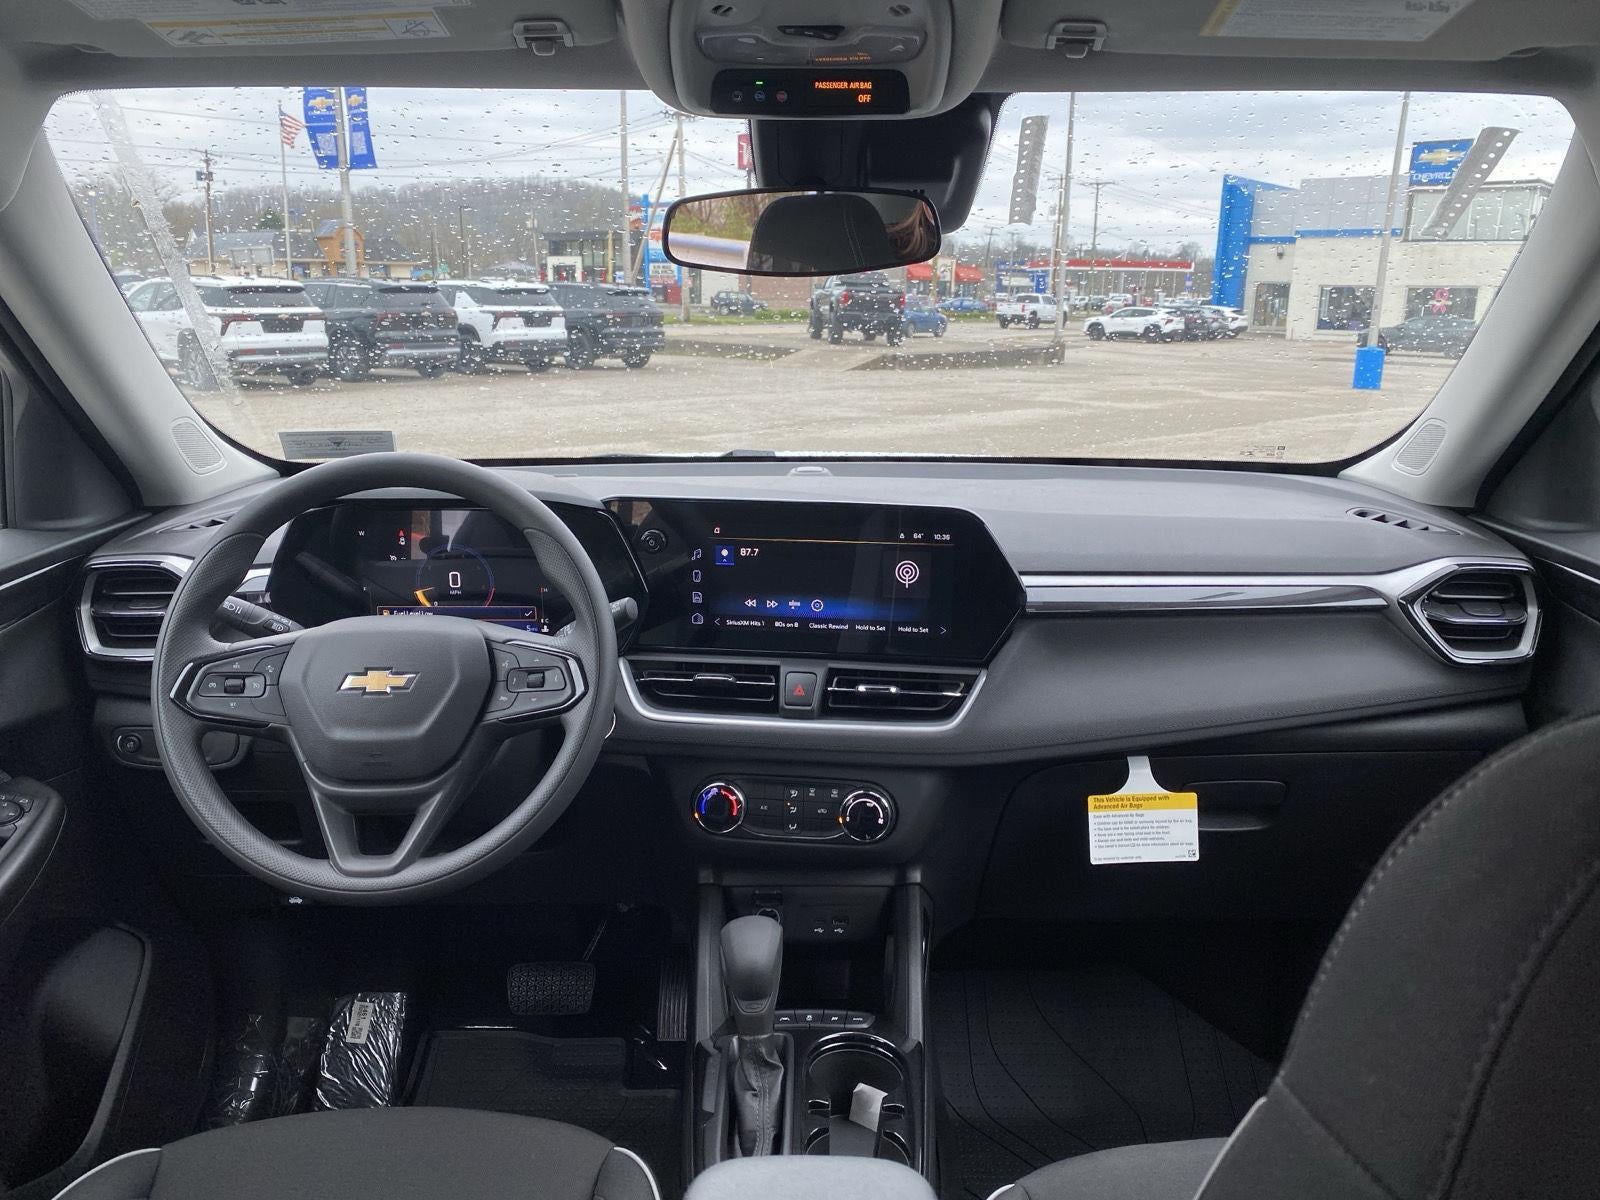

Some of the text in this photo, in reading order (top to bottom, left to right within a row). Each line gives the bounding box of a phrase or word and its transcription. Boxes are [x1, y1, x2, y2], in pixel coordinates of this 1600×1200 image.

[814, 81, 849, 89] PASSENGER
[858, 94, 872, 103] OFF
[740, 547, 760, 557] 87.7
[448, 571, 461, 588] 0
[1105, 795, 1125, 803] Vehicle
[1131, 794, 1158, 803] Equipped
[1158, 793, 1170, 801] with
[1129, 802, 1144, 810] Bags
